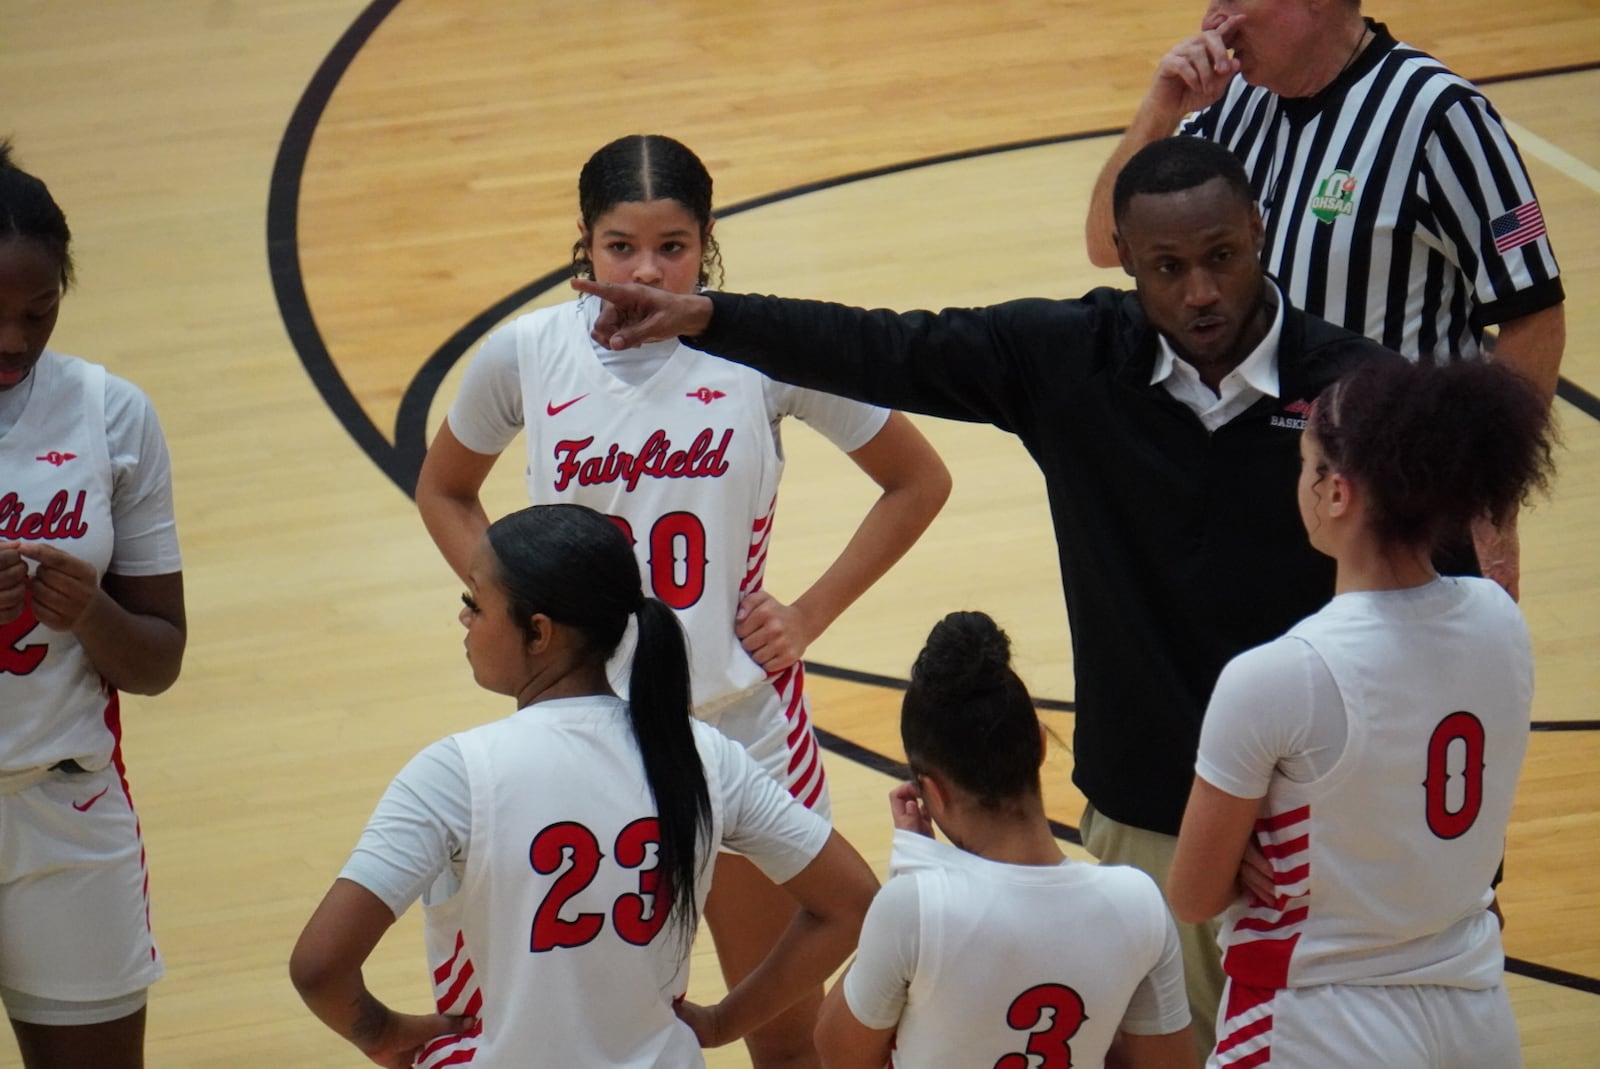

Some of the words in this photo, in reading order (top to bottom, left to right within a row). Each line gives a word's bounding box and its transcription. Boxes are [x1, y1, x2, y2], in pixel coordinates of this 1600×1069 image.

[1311, 196, 1353, 214] OHSAA
[554, 428, 734, 492] Fairfield
[1422, 711, 1486, 840] 0
[529, 816, 676, 953] 23
[993, 983, 1090, 1069] 3
